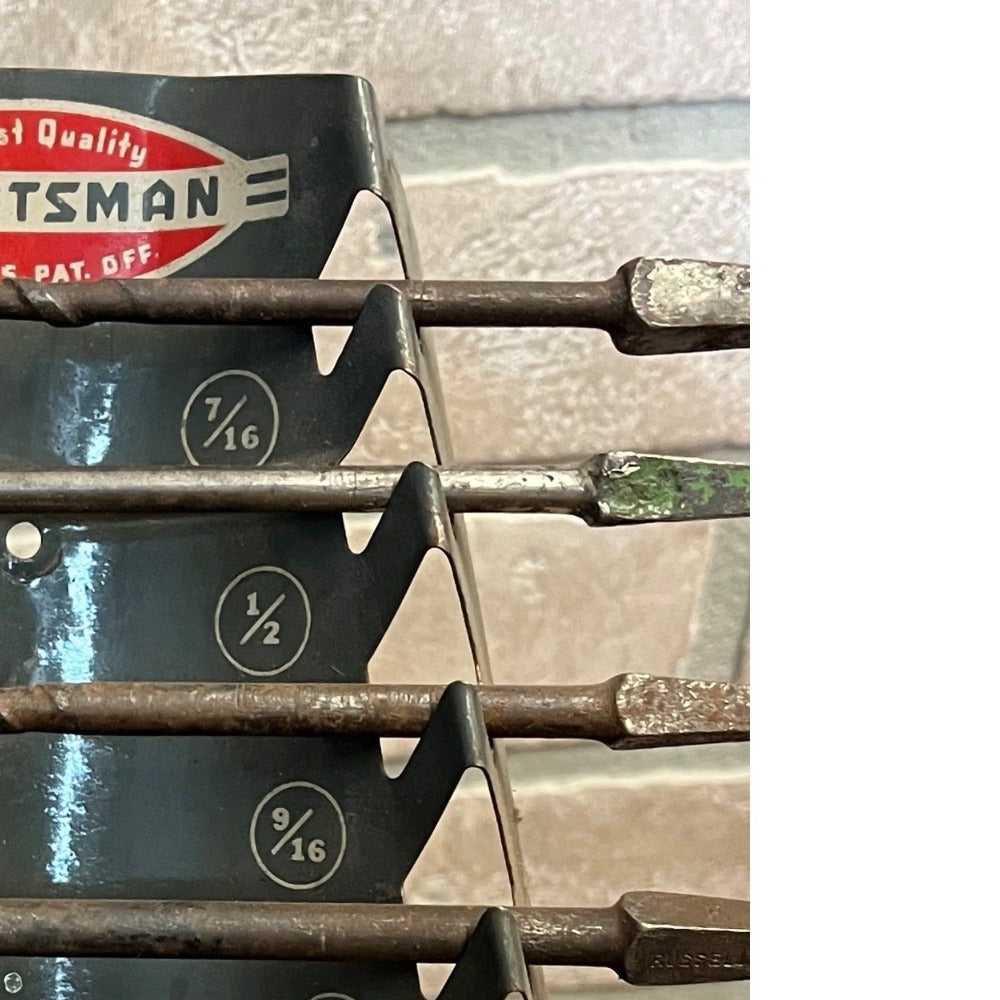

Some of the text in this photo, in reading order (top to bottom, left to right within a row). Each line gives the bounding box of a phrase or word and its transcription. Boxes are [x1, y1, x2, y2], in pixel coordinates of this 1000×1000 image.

[38, 118, 147, 168] Quality
[34, 259, 91, 283] PAT.
[204, 395, 259, 450] 7/16
[239, 592, 285, 645] 1/2
[270, 807, 326, 863] 9/16
